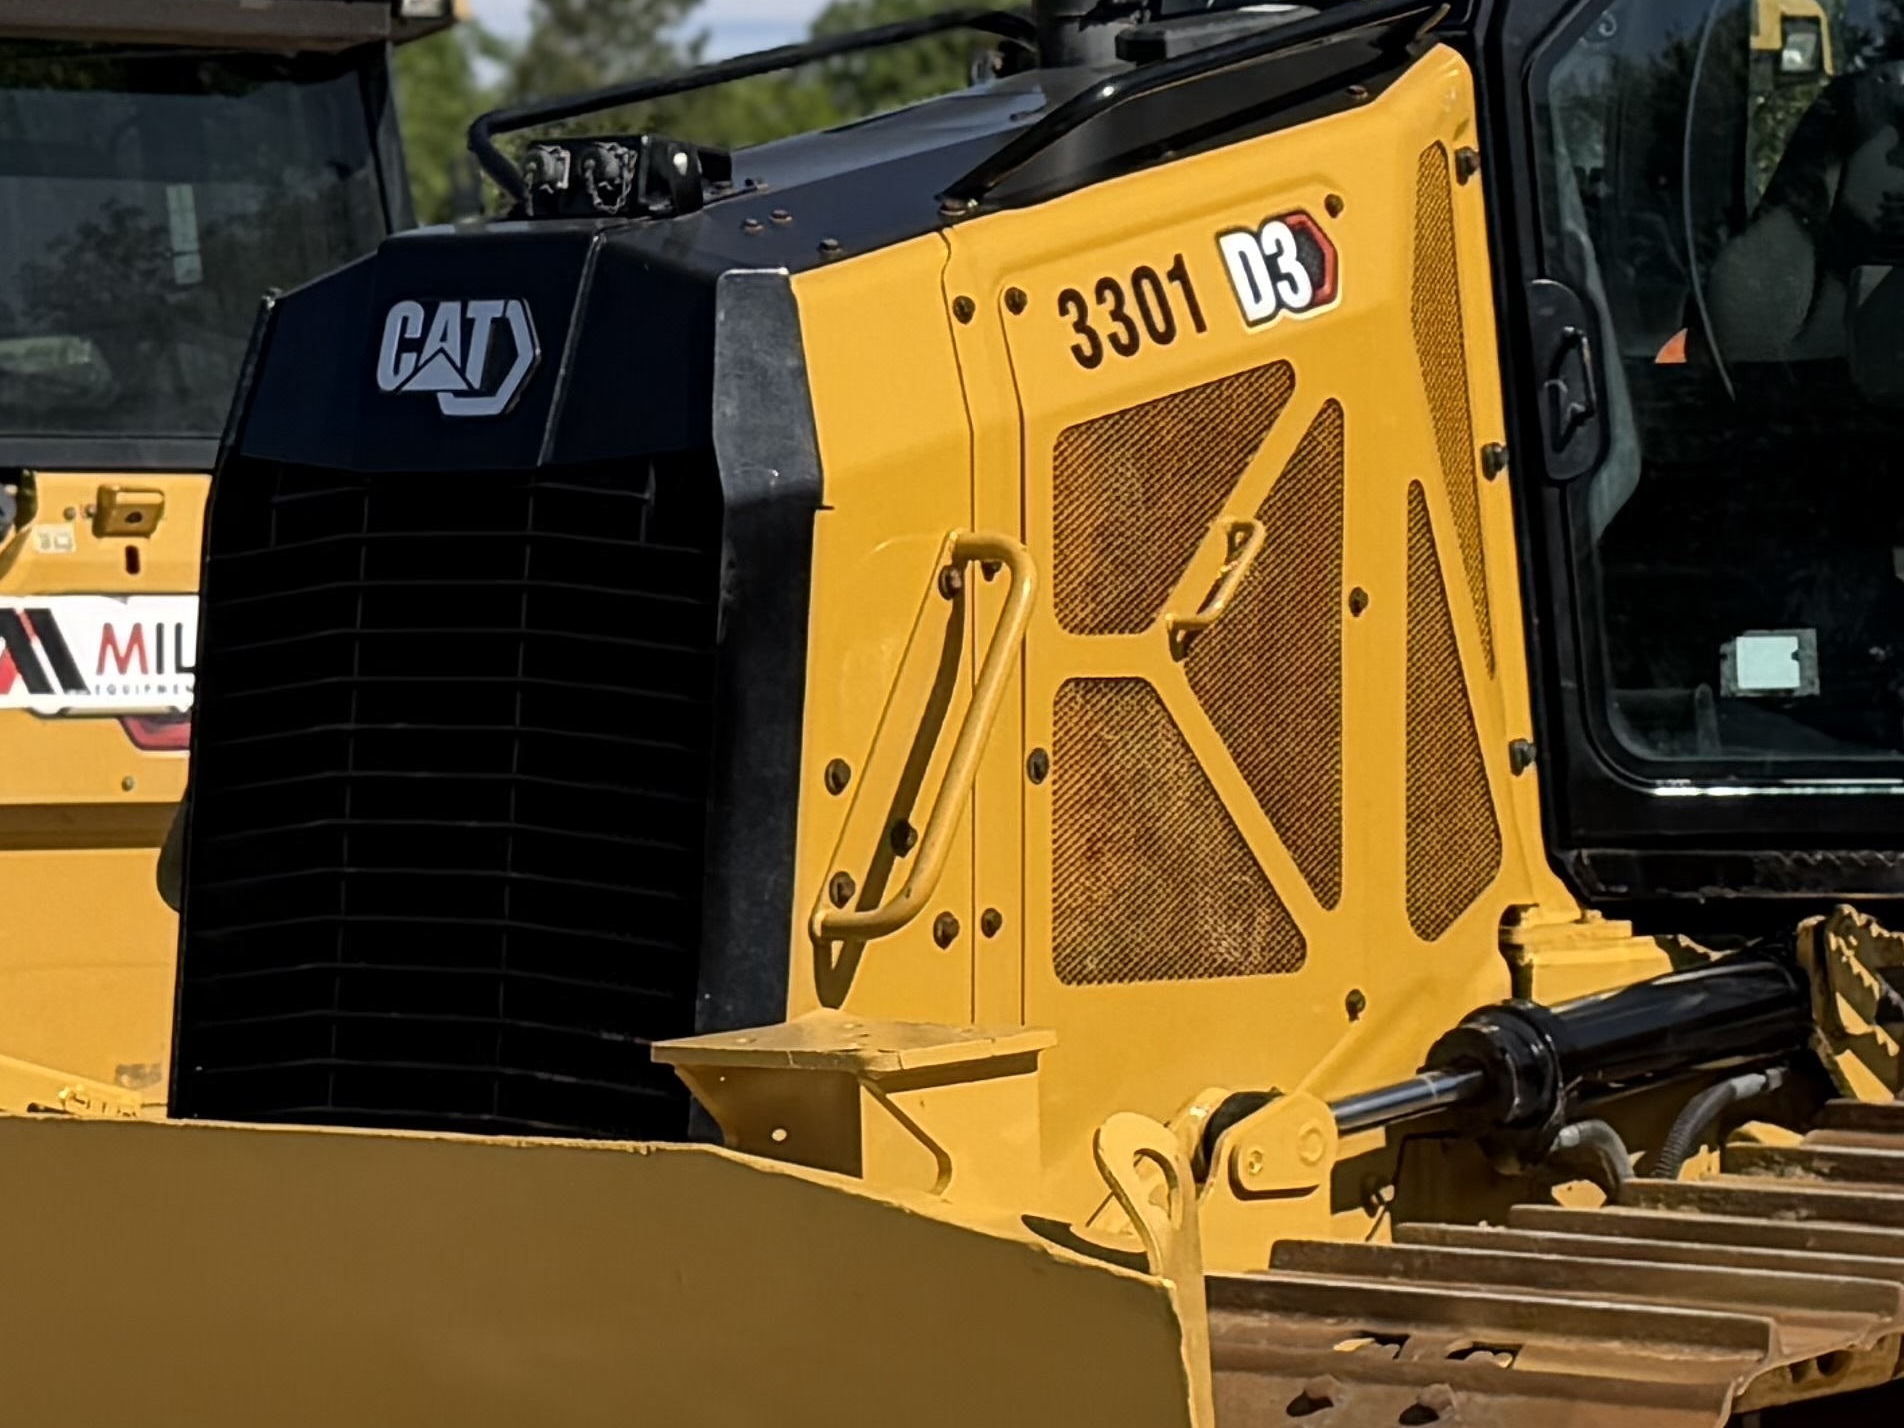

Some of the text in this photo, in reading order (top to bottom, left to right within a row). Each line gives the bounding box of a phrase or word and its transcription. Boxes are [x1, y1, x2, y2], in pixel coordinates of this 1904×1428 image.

[376, 299, 506, 393] CAT
[1057, 220, 1315, 370] 3301 D3
